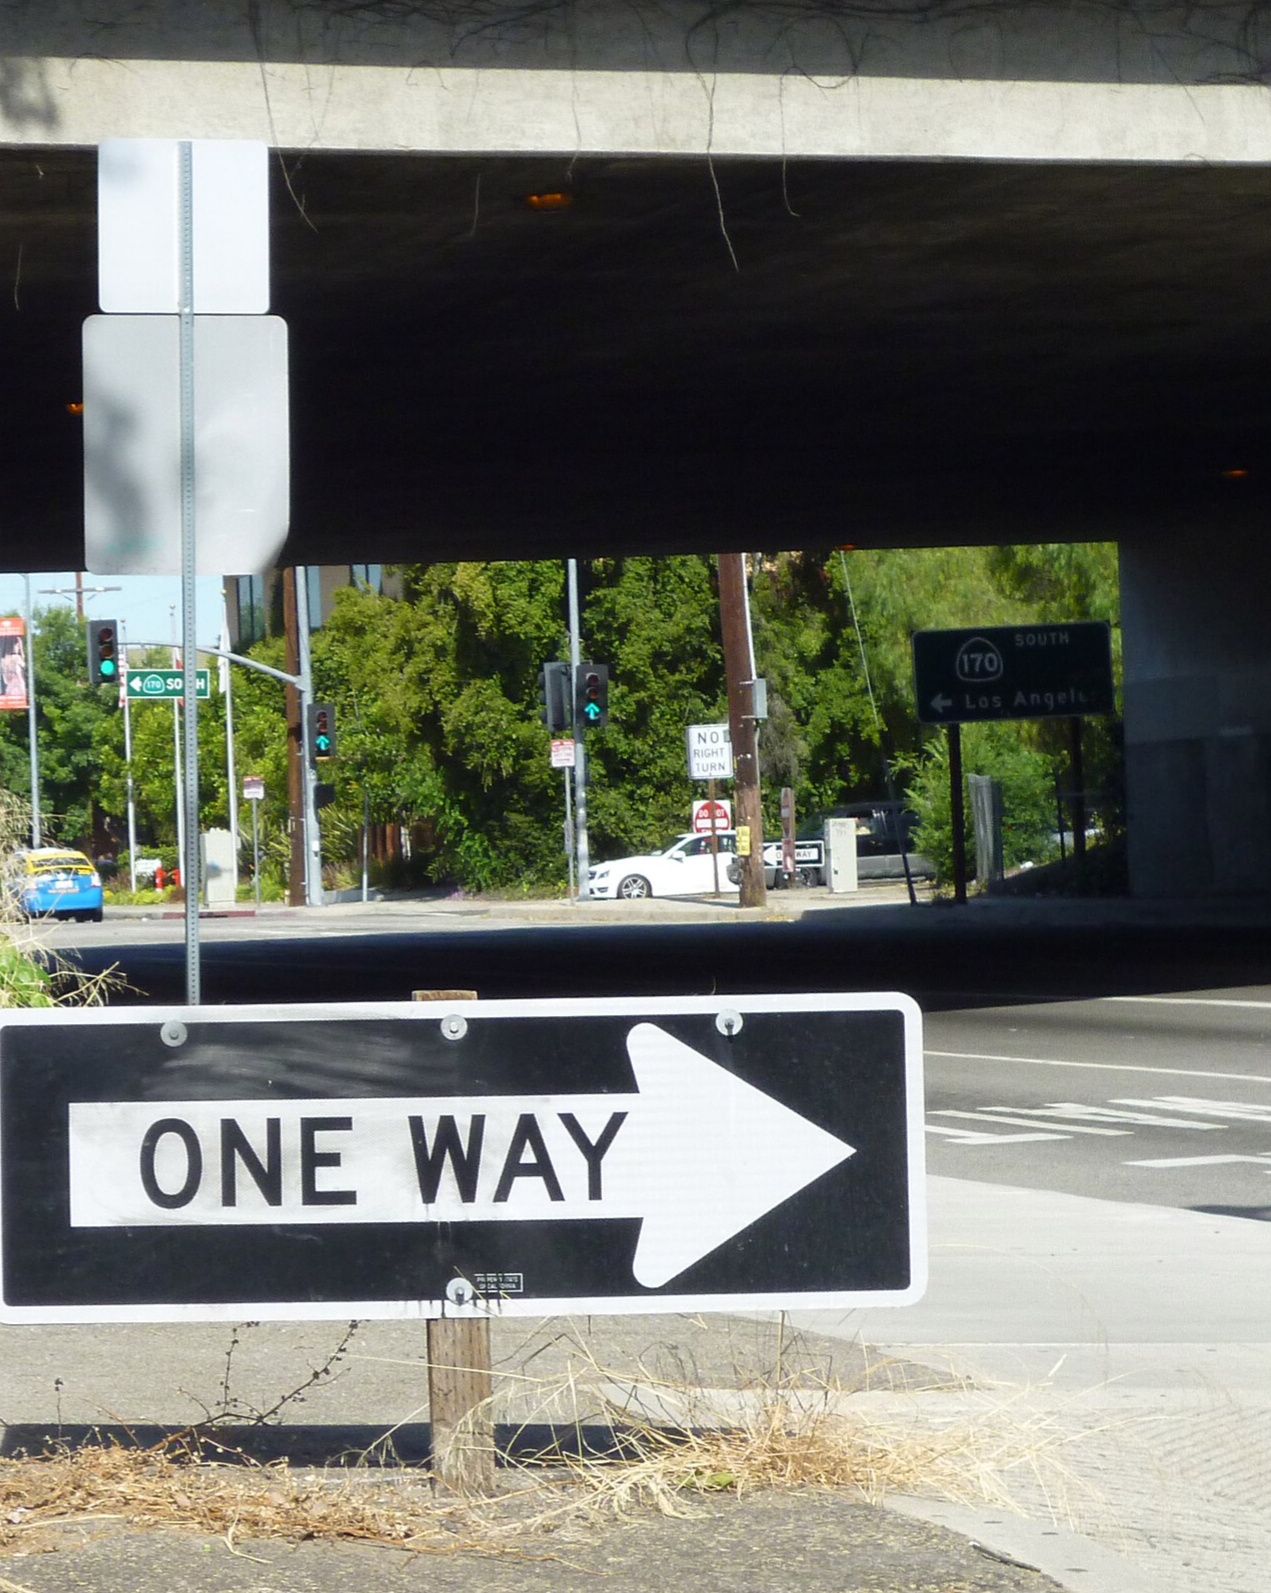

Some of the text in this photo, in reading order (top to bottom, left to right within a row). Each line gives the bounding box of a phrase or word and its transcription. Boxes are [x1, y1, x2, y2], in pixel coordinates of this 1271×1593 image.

[1014, 631, 1070, 647] SOUTH
[962, 653, 998, 674] 170
[146, 678, 205, 690] 170 SOH
[965, 688, 1094, 711] Los Angel
[697, 731, 719, 744] NO
[693, 747, 725, 759] RIGHT
[695, 761, 726, 772] TURN
[698, 809, 709, 818] DO
[796, 850, 812, 859] WAY
[139, 1110, 628, 1209] ONE WAY
